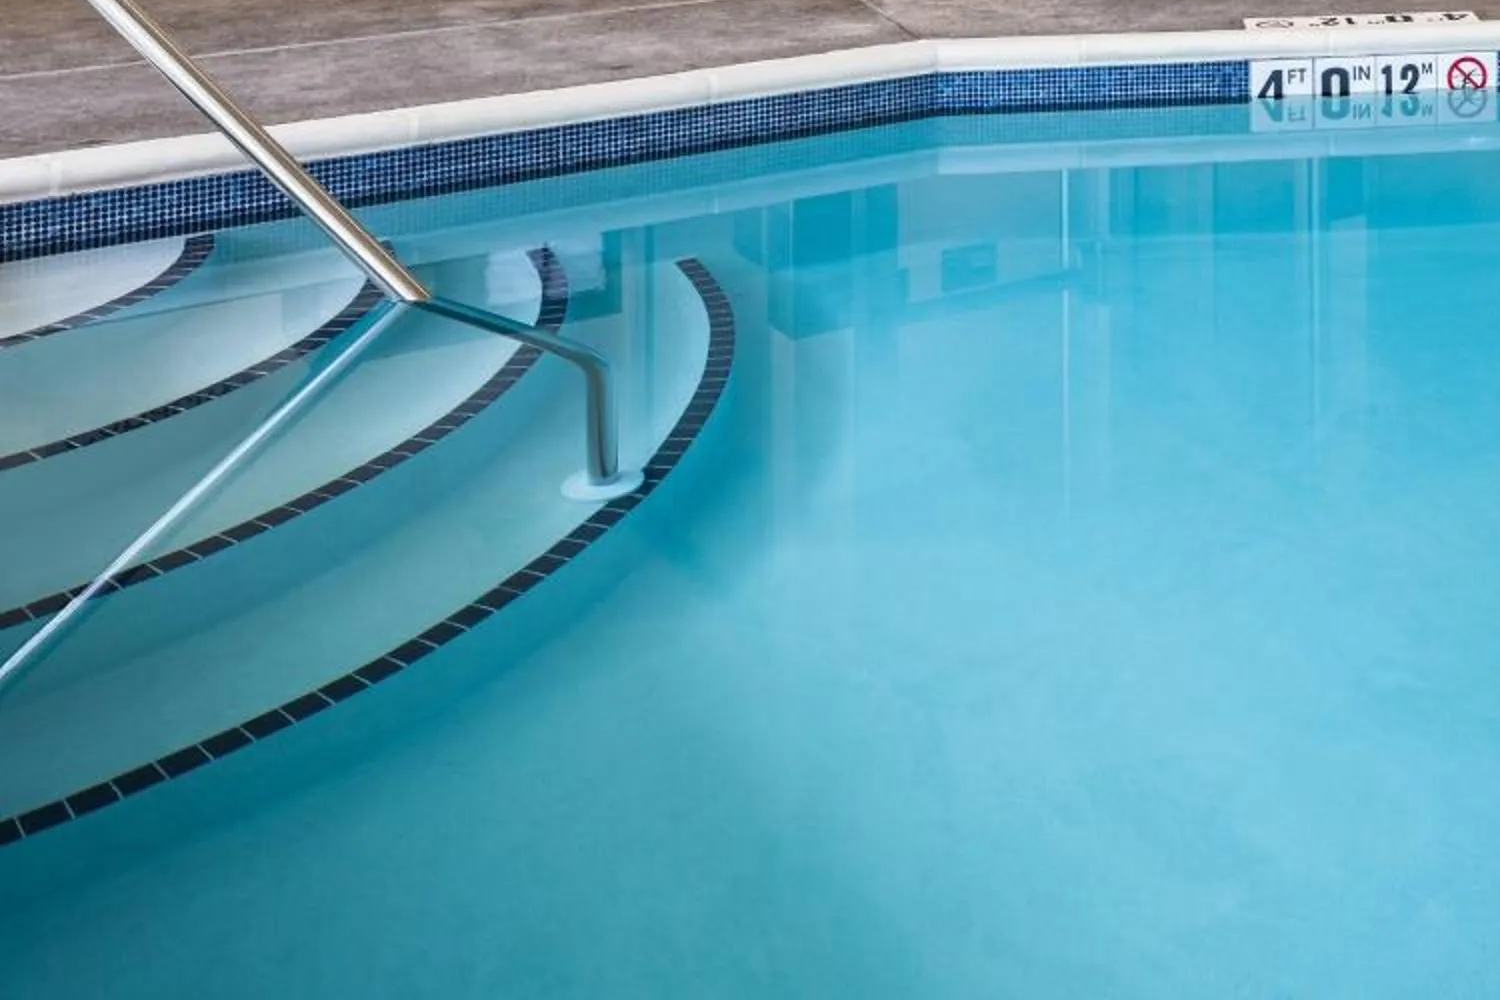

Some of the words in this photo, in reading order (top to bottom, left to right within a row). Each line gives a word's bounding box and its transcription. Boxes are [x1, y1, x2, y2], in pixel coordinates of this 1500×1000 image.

[1257, 69, 1284, 99] 4
[1287, 67, 1307, 84] FT
[1353, 66, 1371, 81] IN
[1421, 62, 1433, 75] M
